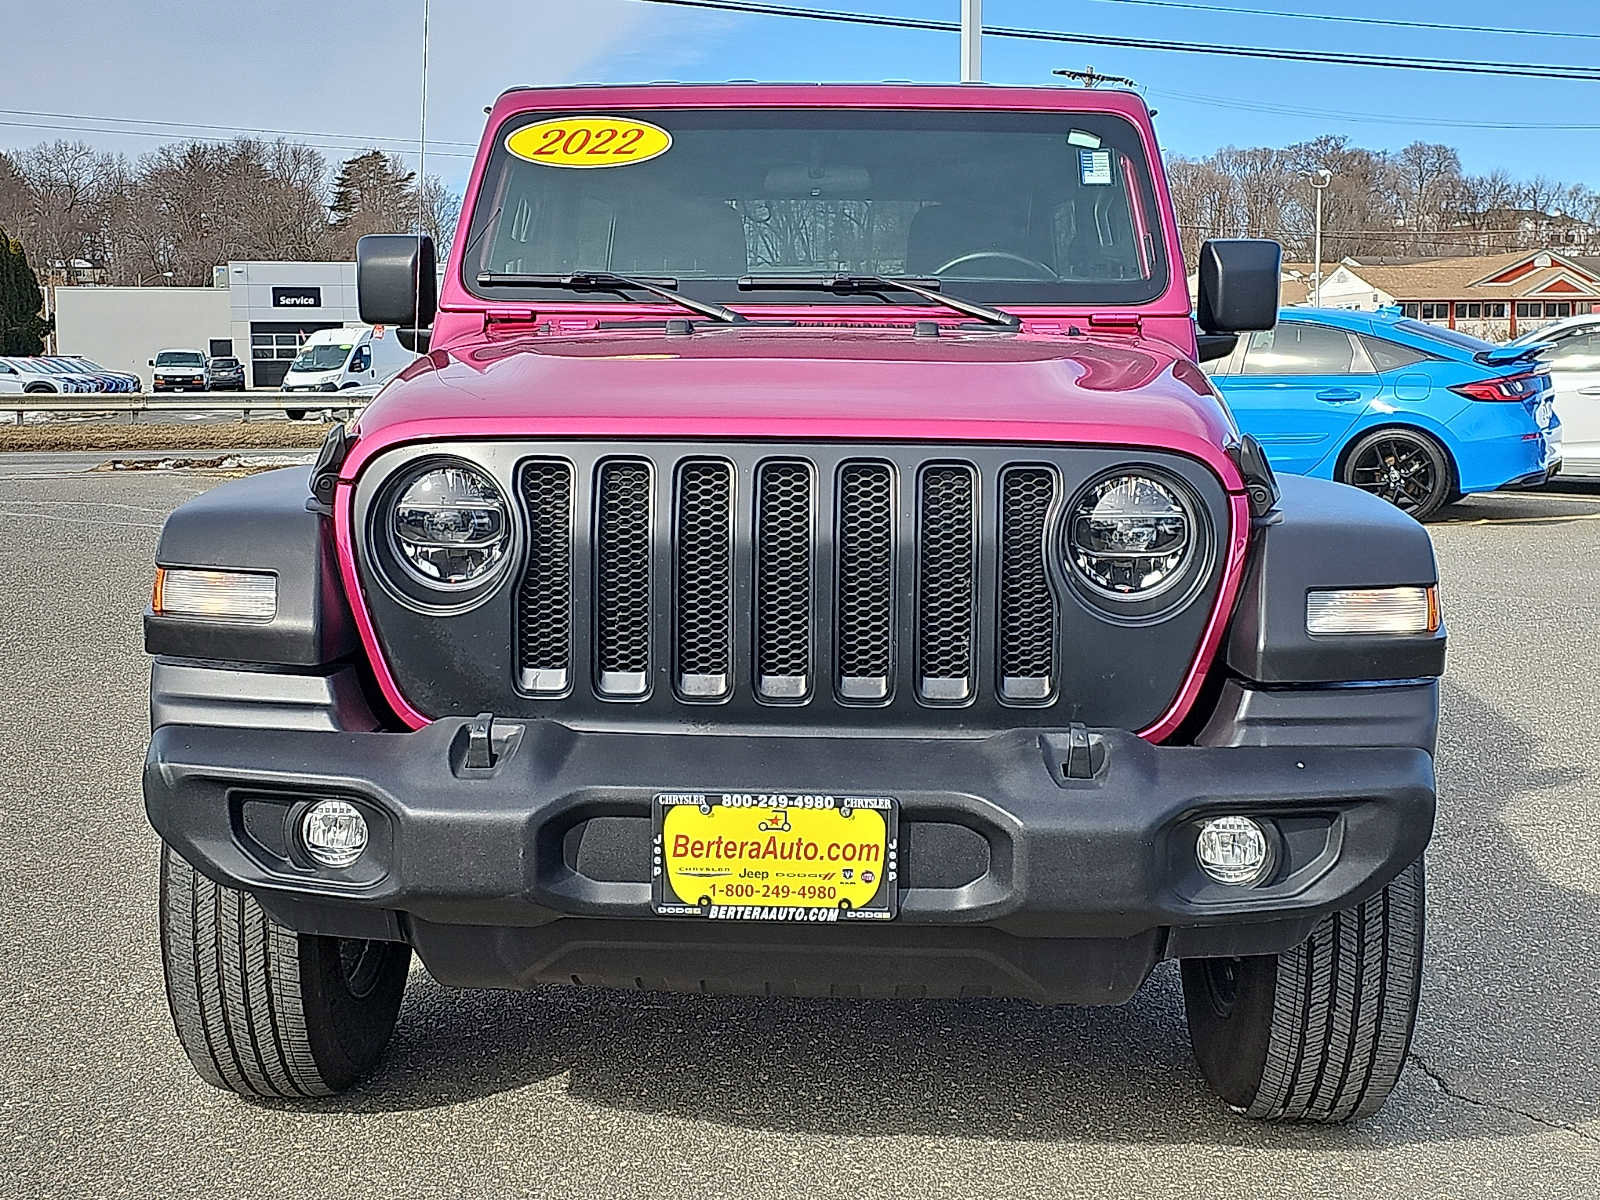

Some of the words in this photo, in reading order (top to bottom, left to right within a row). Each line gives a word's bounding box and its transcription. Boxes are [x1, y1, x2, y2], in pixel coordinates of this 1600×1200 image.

[532, 128, 645, 155] 2022
[279, 296, 315, 305] Service
[658, 795, 706, 805] CHRYSLER
[721, 794, 835, 809] 800-249-4980
[843, 798, 892, 809] CHRYSLER
[653, 834, 662, 877] Jeep
[672, 834, 880, 862] BerteraAuto.com
[888, 839, 897, 882] Jeep
[738, 868, 769, 881] Jeep
[709, 883, 837, 900] 1-800-249-4980
[657, 906, 702, 915] DODGE
[709, 905, 839, 922] BERTERAAUTO.COM
[846, 911, 891, 919] DODGE
